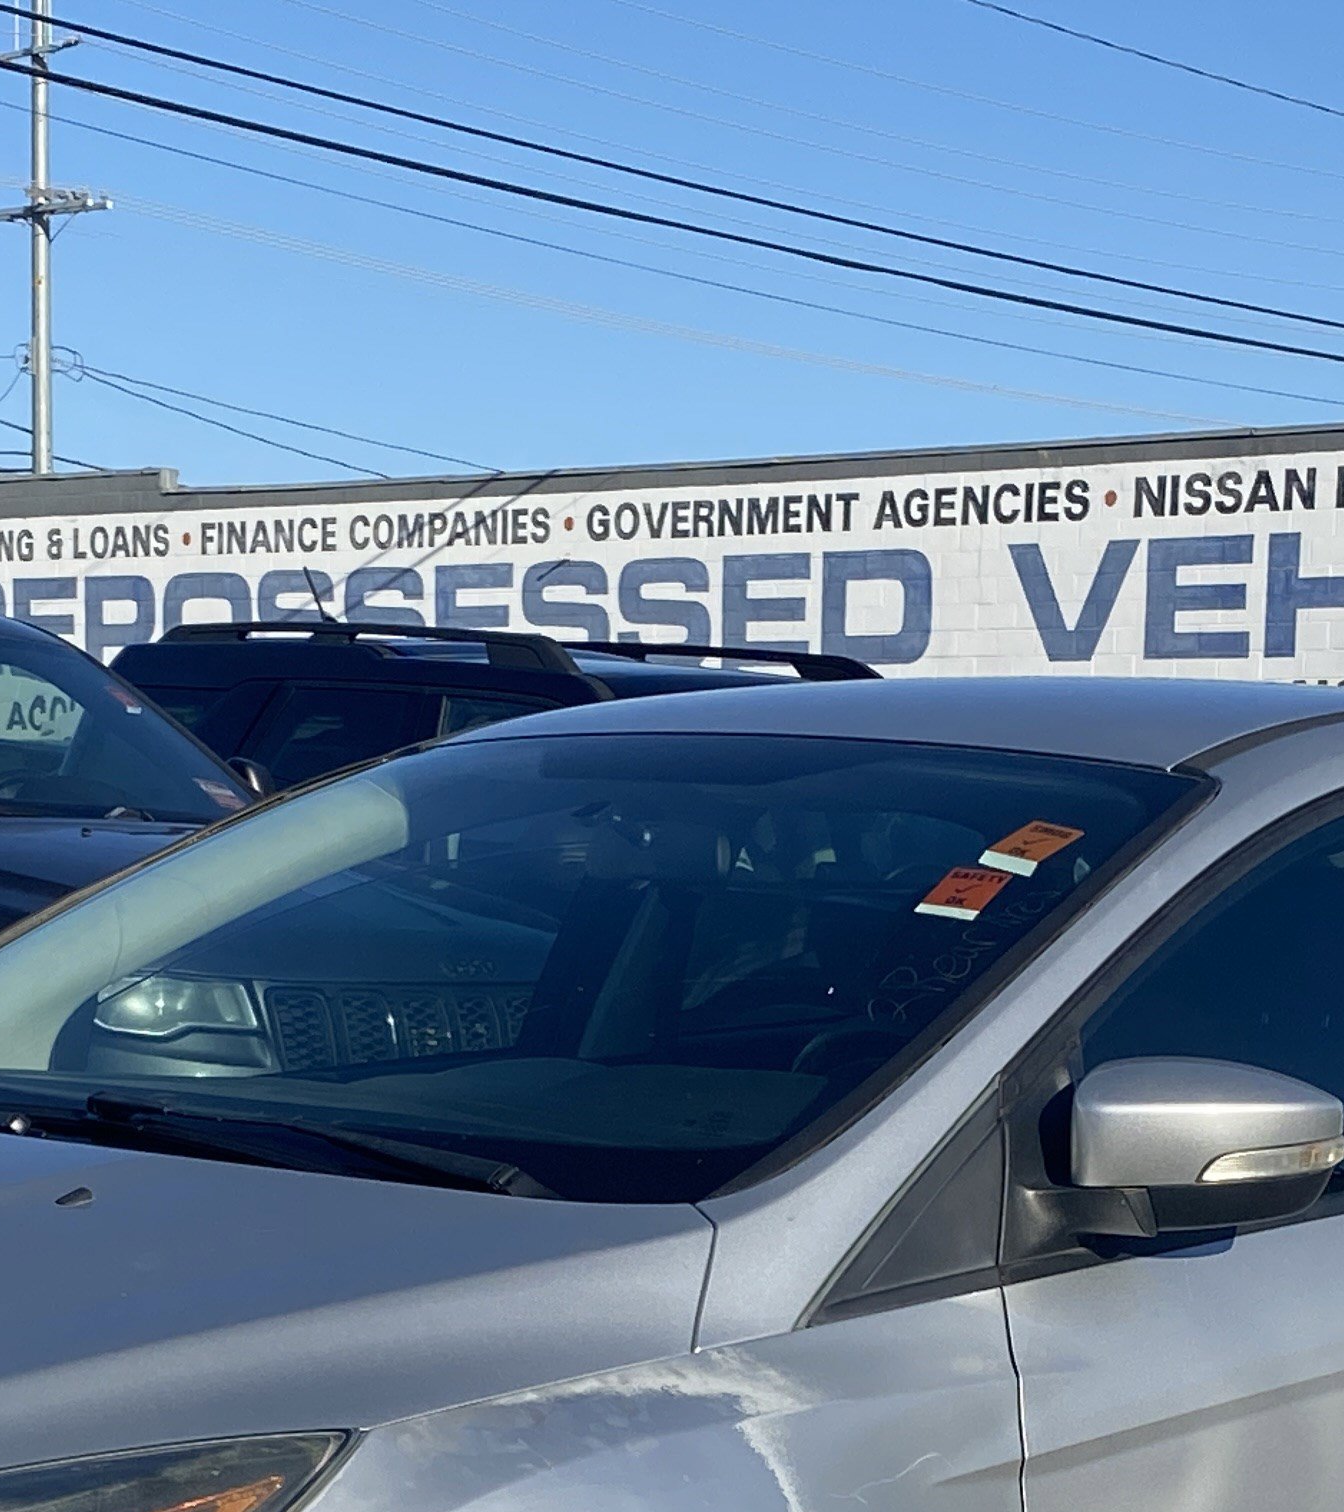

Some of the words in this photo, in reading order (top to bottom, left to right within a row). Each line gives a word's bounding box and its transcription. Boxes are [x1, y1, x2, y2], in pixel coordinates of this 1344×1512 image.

[46, 527, 64, 561] &
[72, 522, 170, 559] LOANS
[199, 516, 338, 555] FINANCE
[349, 507, 551, 551] COMPANIES
[586, 492, 859, 541] GOVERNMENT
[873, 479, 1091, 530] AGENCIES
[1133, 467, 1317, 518] NISSAN
[952, 871, 1008, 884] SAFETY
